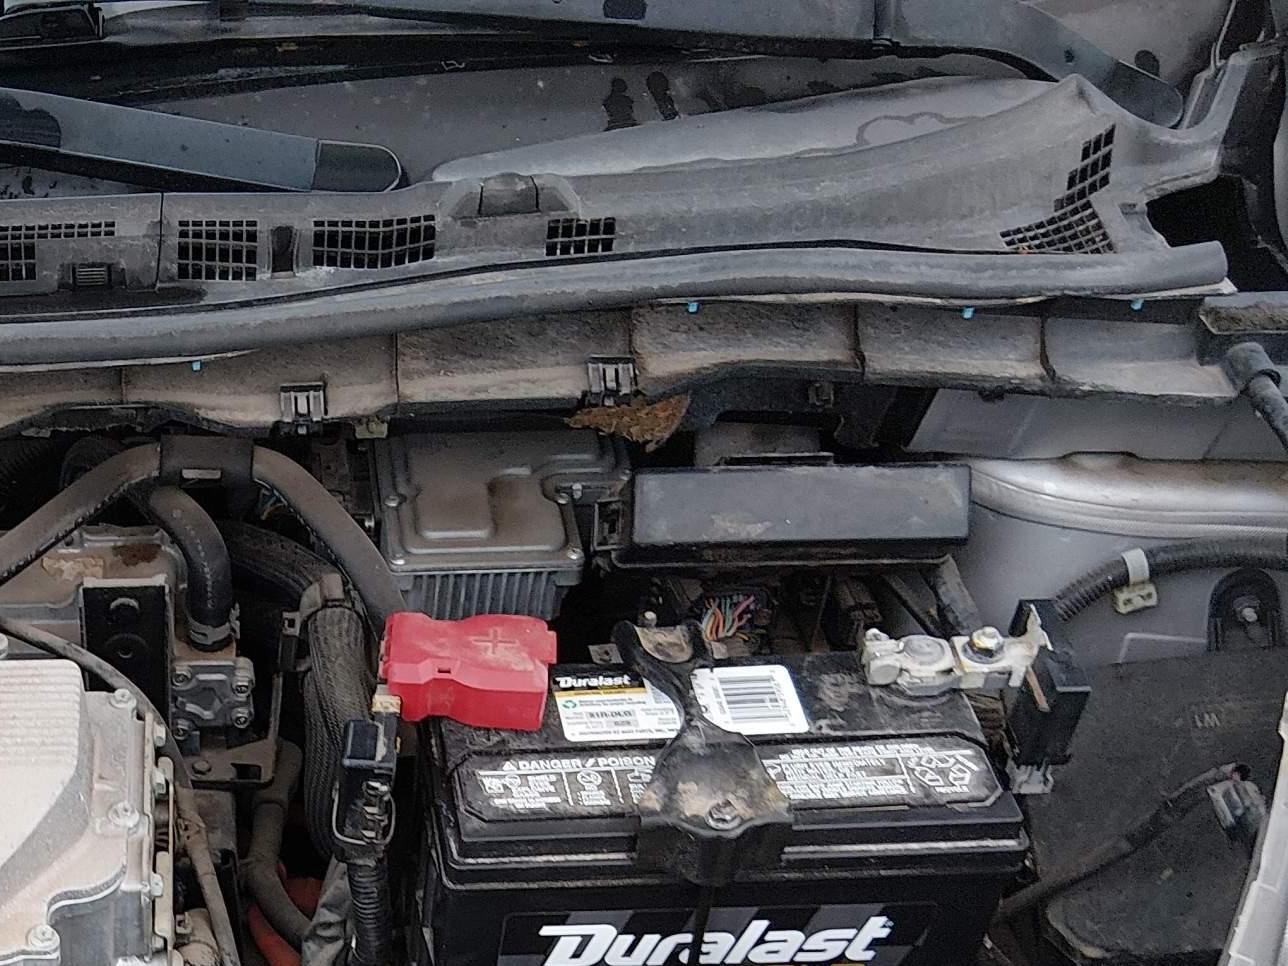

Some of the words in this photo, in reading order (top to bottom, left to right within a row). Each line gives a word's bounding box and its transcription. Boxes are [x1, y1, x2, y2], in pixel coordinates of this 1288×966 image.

[555, 674, 631, 688] Duralast
[519, 759, 582, 770] DANGER
[599, 756, 656, 767] POISON
